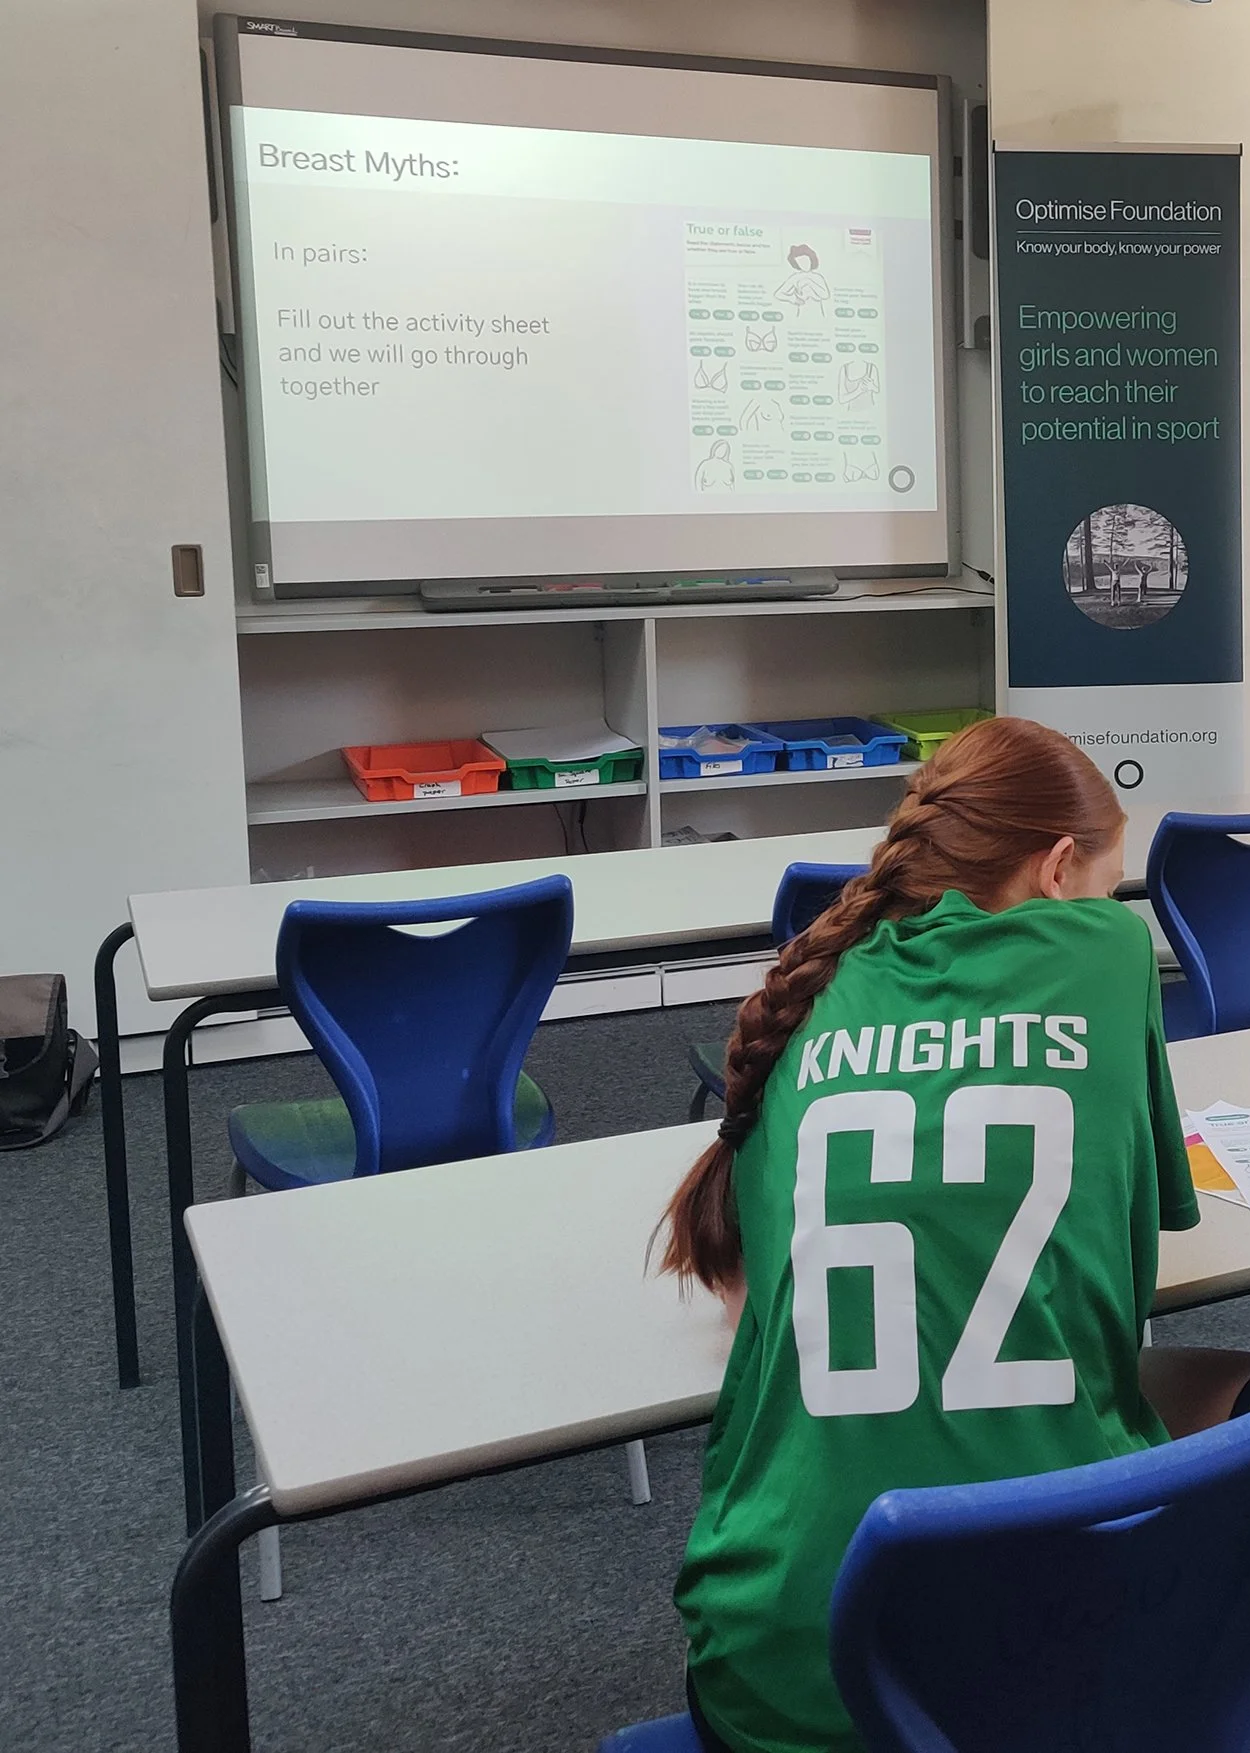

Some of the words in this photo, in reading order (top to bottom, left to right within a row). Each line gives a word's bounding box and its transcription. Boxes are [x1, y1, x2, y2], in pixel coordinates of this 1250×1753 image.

[258, 143, 356, 173] Breast
[364, 150, 460, 182] Myths:
[1016, 199, 1106, 223] Optimise
[1110, 201, 1222, 222] Foundation
[686, 222, 714, 235] True
[718, 227, 730, 236] or
[733, 225, 764, 238] false
[273, 241, 295, 261] In
[303, 243, 368, 267] pairs:
[1016, 240, 1052, 254] Know
[1054, 243, 1082, 257] your
[1084, 241, 1117, 257] body,
[1119, 242, 1152, 255] know
[1154, 245, 1180, 257] your
[1183, 243, 1222, 257] power
[277, 308, 311, 329] Fill
[318, 312, 357, 330] out
[362, 311, 400, 332] the
[406, 313, 486, 338] activity
[491, 314, 551, 335] sheet
[1019, 305, 1177, 335] Empowering
[279, 342, 322, 363] and
[329, 347, 361, 364] we
[367, 344, 404, 364] will
[411, 349, 438, 369] go
[443, 345, 529, 371] through
[1019, 342, 1070, 372] girls
[1075, 342, 1122, 367] and
[1126, 347, 1218, 367] women
[280, 376, 380, 401] together
[1020, 381, 1045, 404] to
[1050, 379, 1120, 404] reach
[1124, 378, 1179, 404] their
[1021, 417, 1127, 445] potential
[1131, 416, 1152, 440] in
[1156, 417, 1221, 444] sport
[797, 1014, 1088, 1091] KNIGHTS
[791, 1085, 1076, 1417] 62
